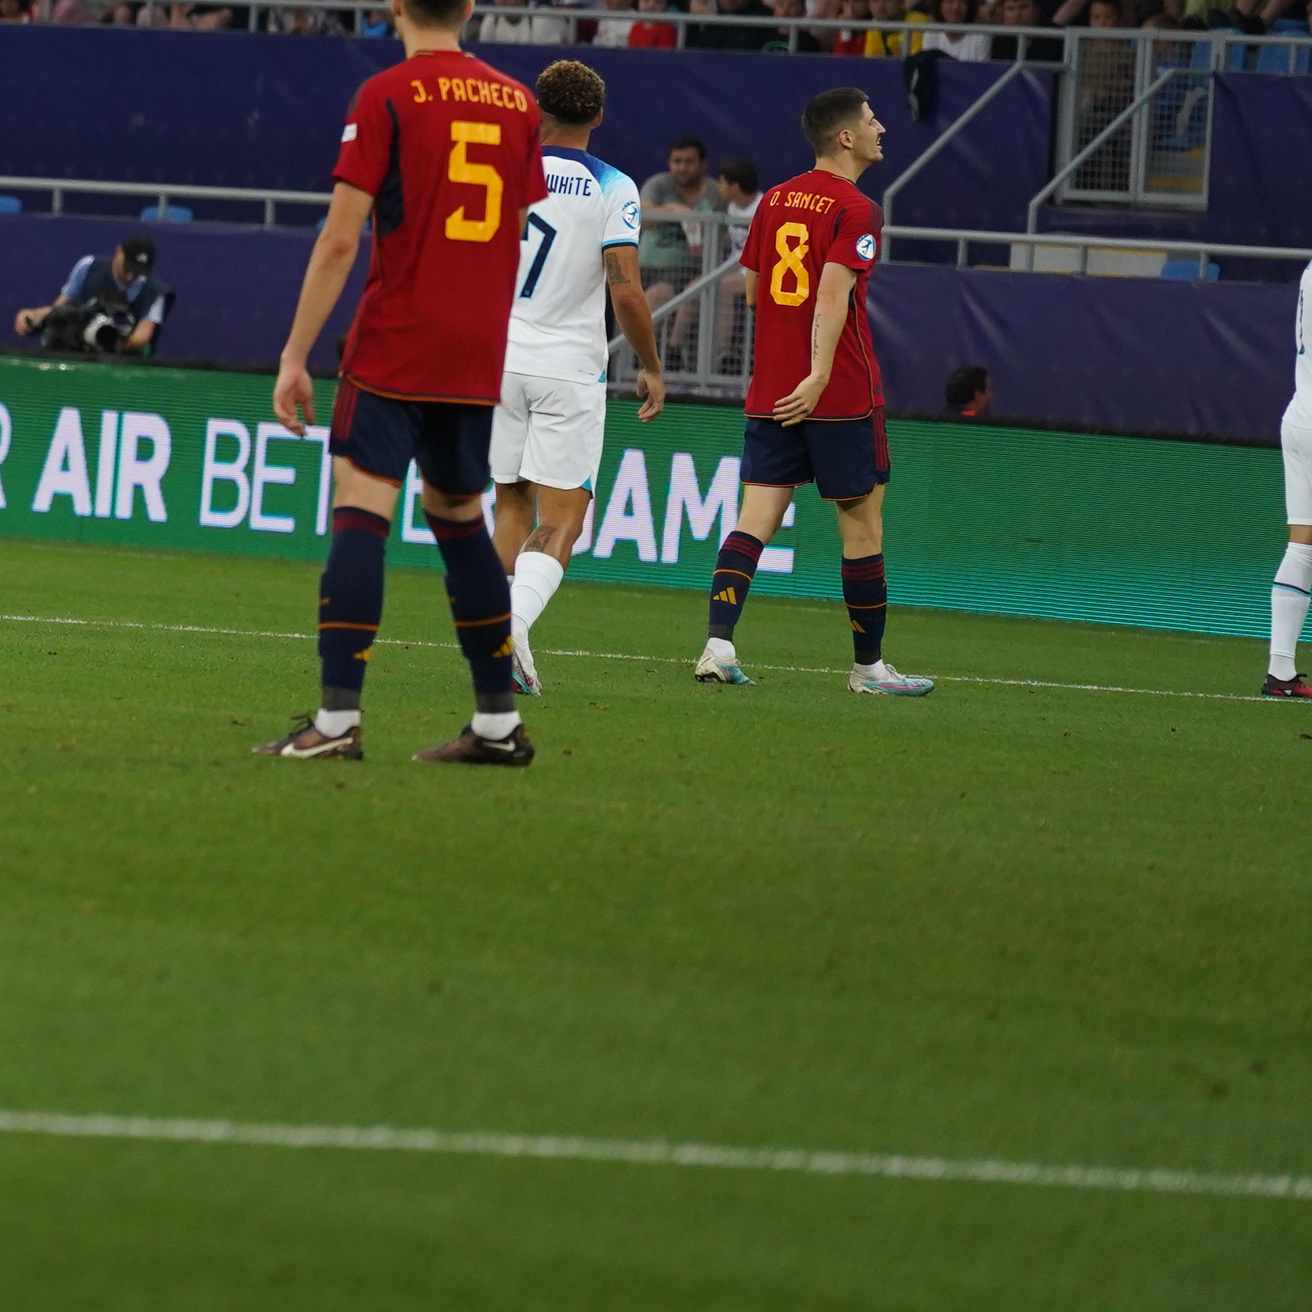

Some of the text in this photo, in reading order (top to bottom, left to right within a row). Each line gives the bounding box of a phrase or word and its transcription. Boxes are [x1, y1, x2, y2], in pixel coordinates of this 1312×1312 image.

[410, 76, 528, 113] J. PACHECO
[445, 120, 504, 243] 5
[784, 191, 836, 215] SANCET
[519, 211, 558, 299] 7
[769, 221, 810, 307] 8
[31, 405, 173, 524] AIR
